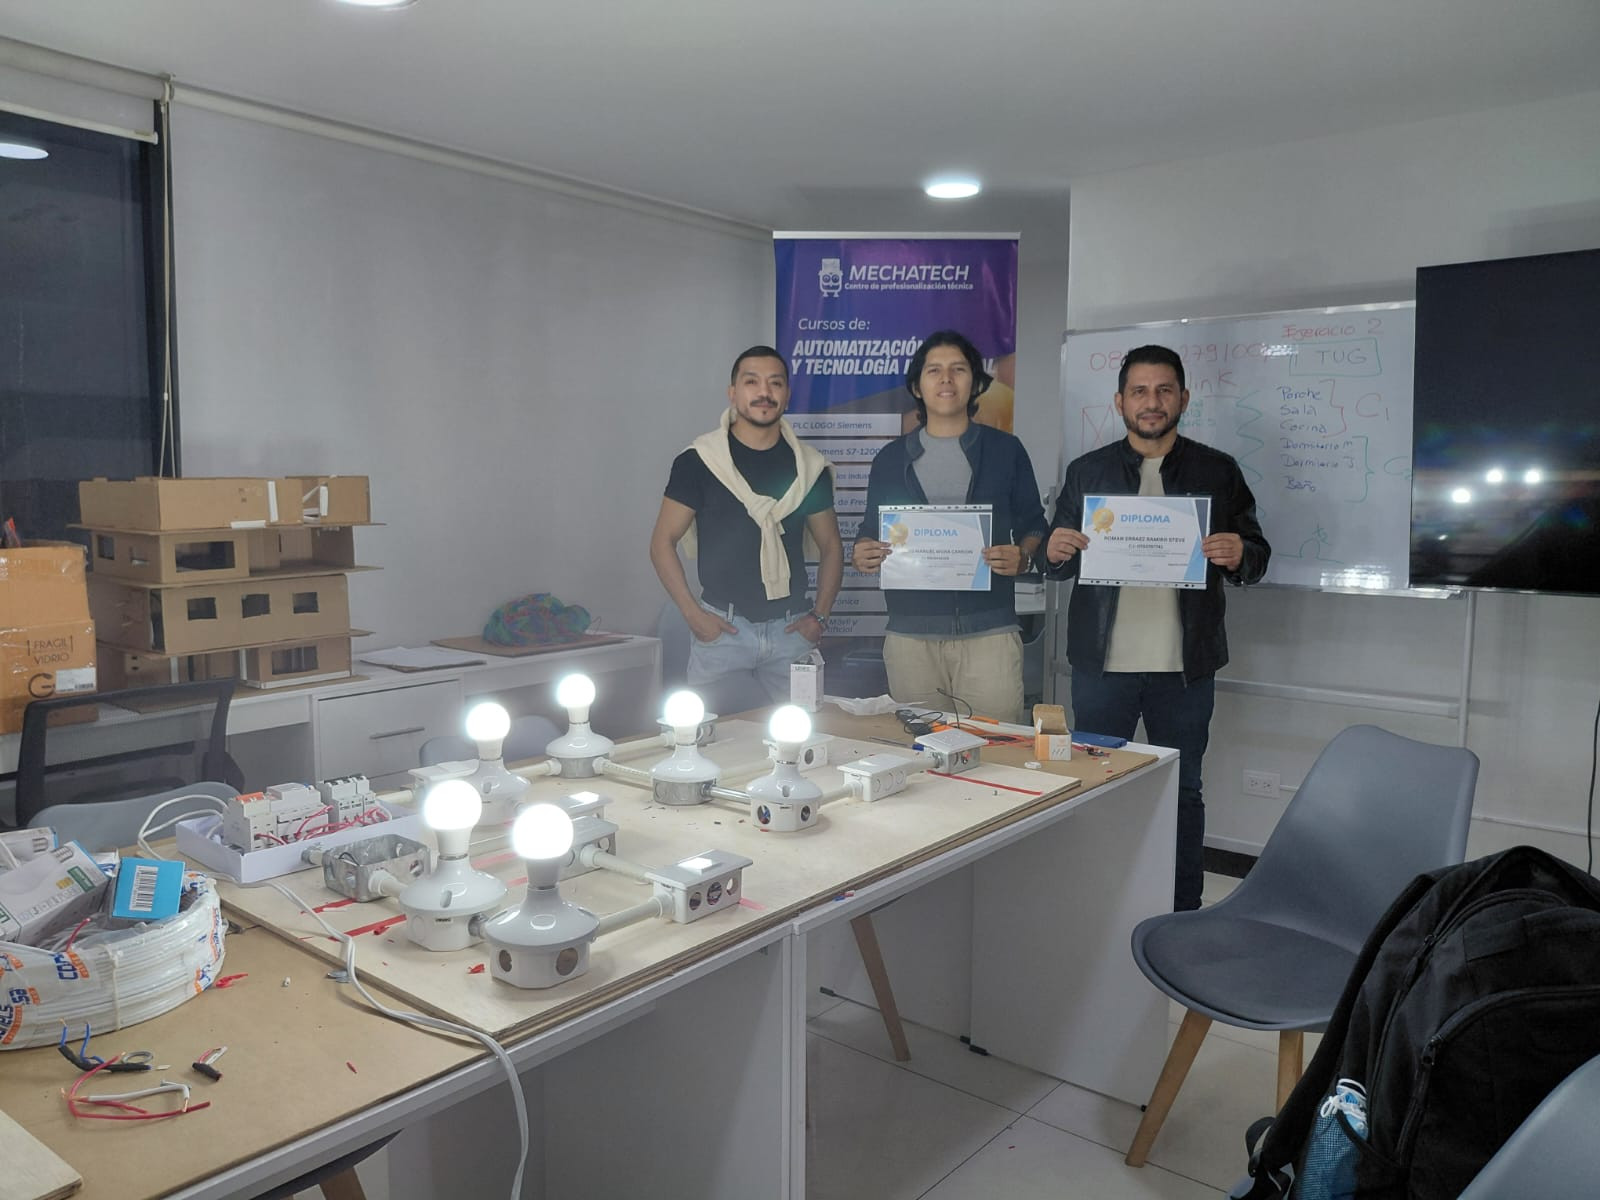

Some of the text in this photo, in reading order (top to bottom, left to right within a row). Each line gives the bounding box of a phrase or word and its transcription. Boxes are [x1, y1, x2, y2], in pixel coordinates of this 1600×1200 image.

[848, 265, 970, 281] MECHATECH
[844, 282, 974, 292] Centro de profesionalización técnica
[798, 317, 871, 331] Cursos de:
[1367, 318, 1384, 335] 2
[1315, 348, 1368, 366] TUG
[791, 358, 803, 375] Y
[805, 355, 900, 376] TECNOLOGÍA
[1280, 403, 1317, 416] Sala
[792, 422, 809, 430] PLC
[837, 421, 872, 430] Siemens
[817, 448, 845, 456] emens
[1120, 514, 1171, 524] DIPLOMA
[914, 528, 959, 537] DIPLOMA
[33, 638, 69, 649] FRAGIL
[33, 652, 70, 665] VIDRIO
